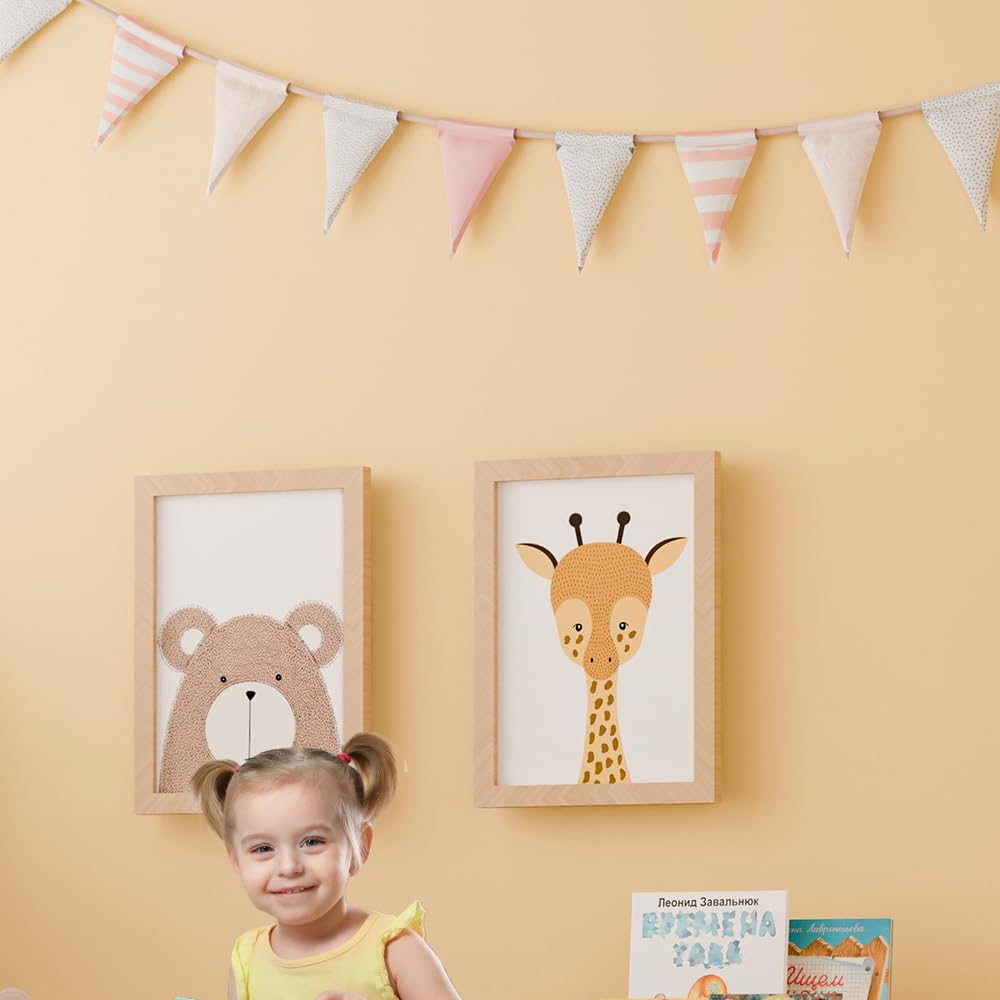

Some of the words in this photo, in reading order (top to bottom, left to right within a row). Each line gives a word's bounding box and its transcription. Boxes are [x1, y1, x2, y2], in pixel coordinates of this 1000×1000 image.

[657, 897, 698, 908] Леонид
[700, 896, 760, 907] Завальнюк
[786, 965, 845, 991] Ищем
